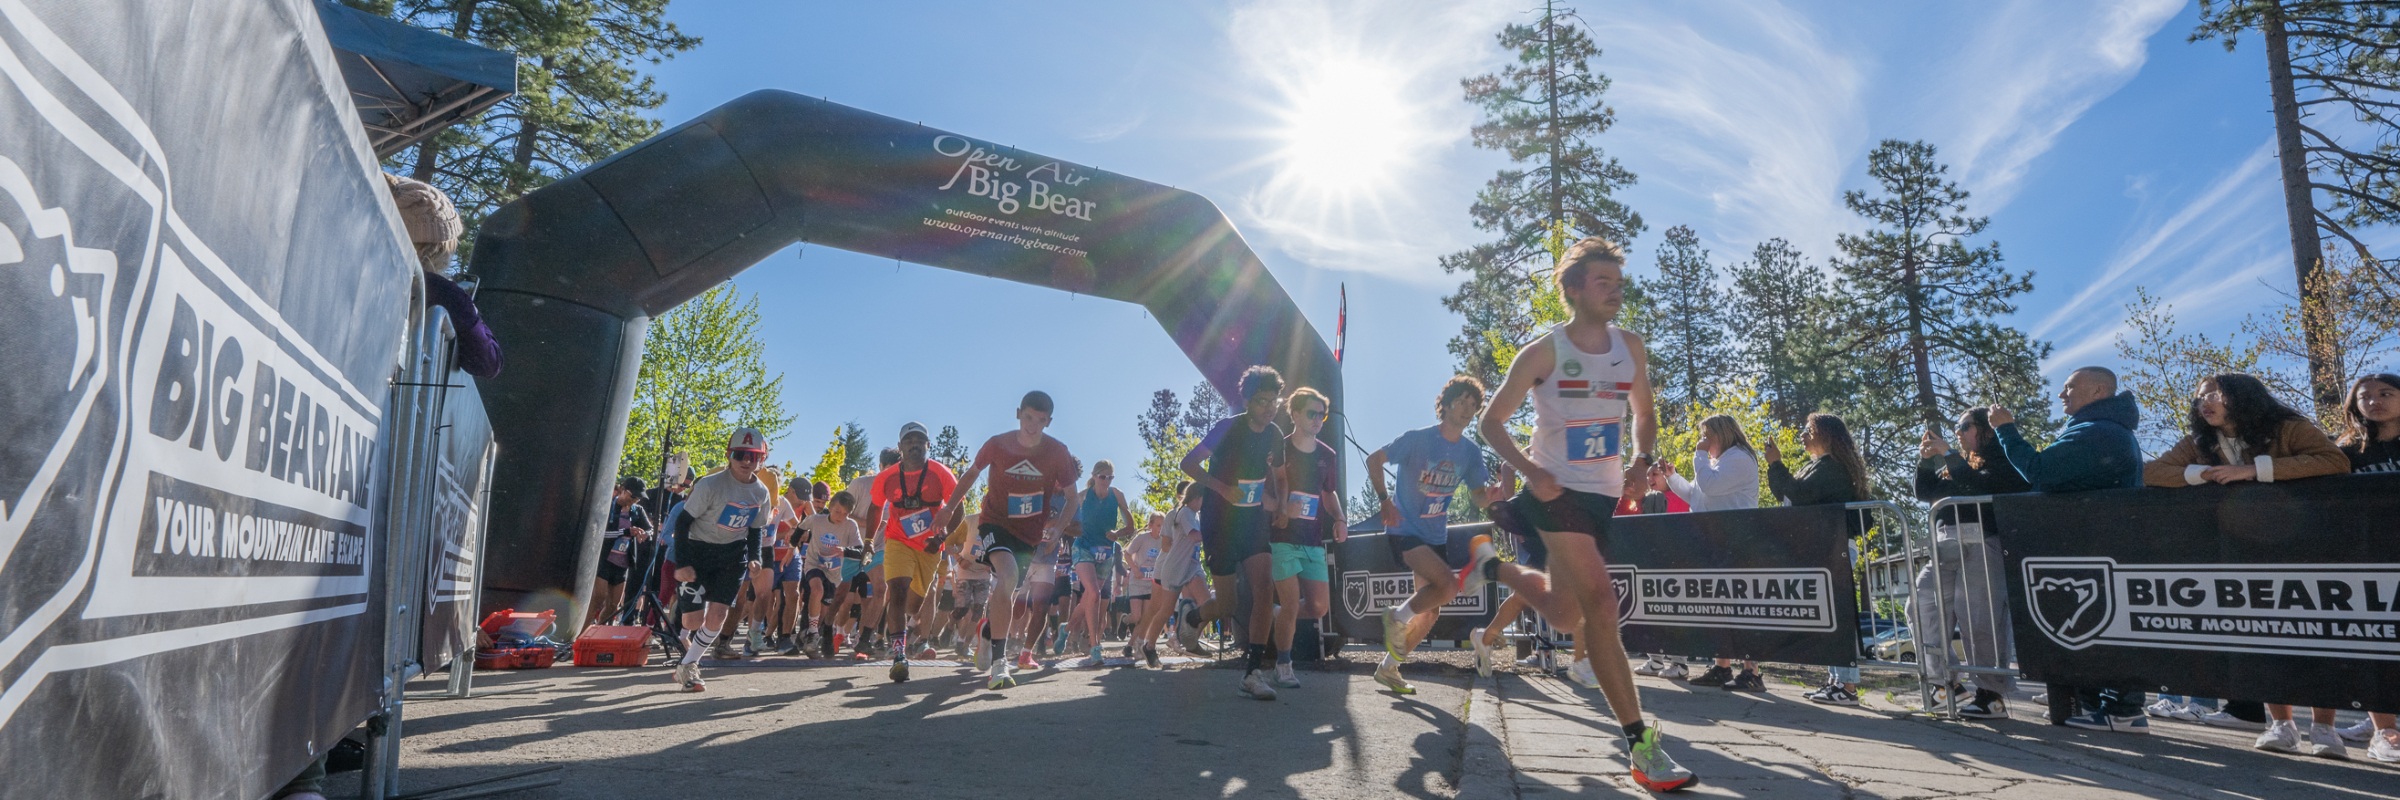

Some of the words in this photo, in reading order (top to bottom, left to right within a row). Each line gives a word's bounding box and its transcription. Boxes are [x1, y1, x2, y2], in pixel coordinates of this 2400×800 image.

[933, 135, 1021, 190] Open
[1026, 162, 1090, 187] Air
[968, 164, 1021, 215] Big
[1028, 179, 1096, 221] Bear
[945, 207, 987, 223] outdoor
[988, 217, 1019, 230] events
[1021, 224, 1042, 235] with
[923, 216, 1088, 258] www.openairbigbear.com
[149, 293, 244, 462] BIG
[245, 360, 330, 494] BEAR
[742, 432, 753, 445] A
[1584, 437, 1607, 459] 24
[1247, 490, 1255, 504] 6
[1019, 502, 1032, 515] 15
[153, 497, 215, 557] YOUR
[221, 511, 308, 563] MOUNTAIN
[304, 526, 335, 564] LAKE
[728, 514, 749, 529] 126
[911, 519, 927, 534] 82
[1095, 551, 1106, 561] 114
[1372, 579, 1396, 595] BIG
[1399, 579, 1415, 594] BE
[1642, 578, 1681, 598] BIG
[1685, 578, 1748, 599] BEAR
[1752, 578, 1818, 600] LAKE
[2126, 577, 2206, 608] BIG
[2214, 578, 2354, 611] BEAR
[2363, 580, 2400, 612] L
[1647, 604, 1674, 613] YOUR
[1677, 604, 1735, 615] MOUNTAIN
[1737, 606, 1766, 616] LAKE
[1769, 606, 1816, 618] ESCAPE
[2137, 615, 2194, 631] YOUR
[2201, 618, 2324, 636] MOUNTAIN
[2331, 622, 2396, 639] LAKE
